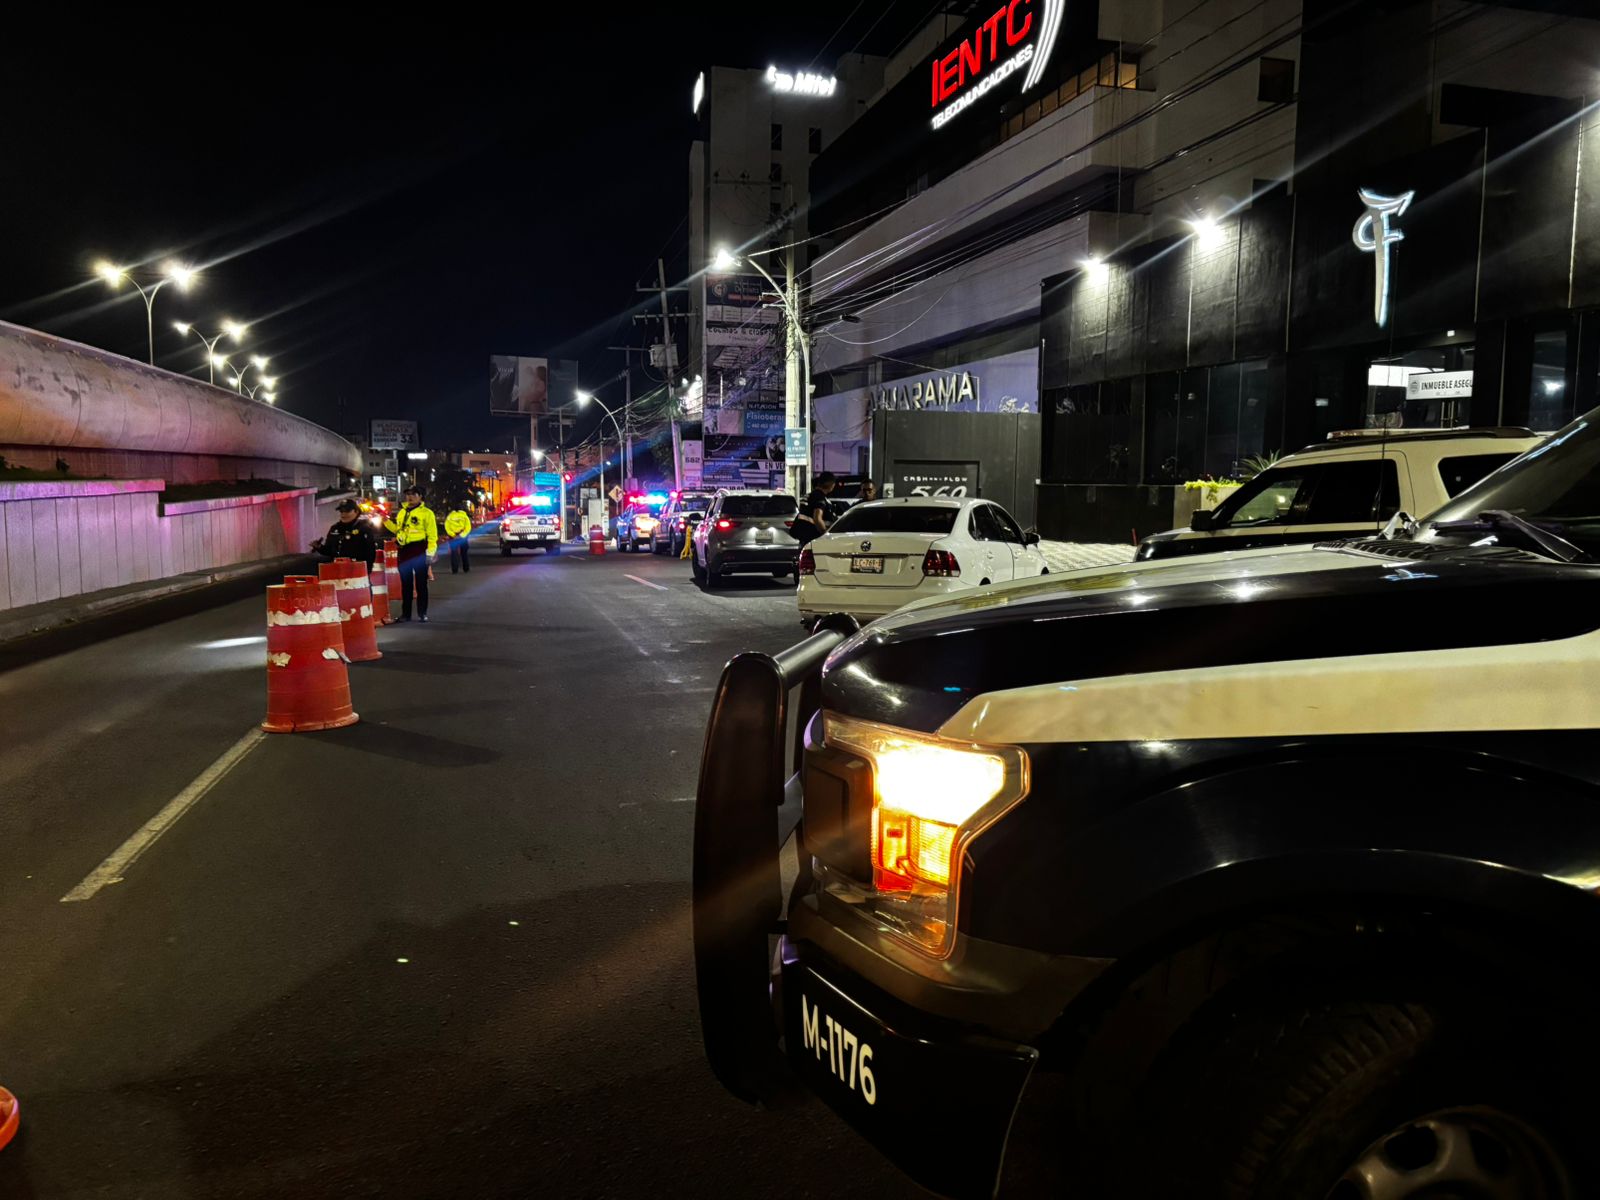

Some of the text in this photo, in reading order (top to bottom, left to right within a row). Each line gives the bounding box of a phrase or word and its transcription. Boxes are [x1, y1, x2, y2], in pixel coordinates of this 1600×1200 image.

[930, 43, 1035, 131] TELECOMUNICACIONES
[1421, 380, 1453, 390] INMUEBLE
[801, 993, 877, 1106] M-1176
